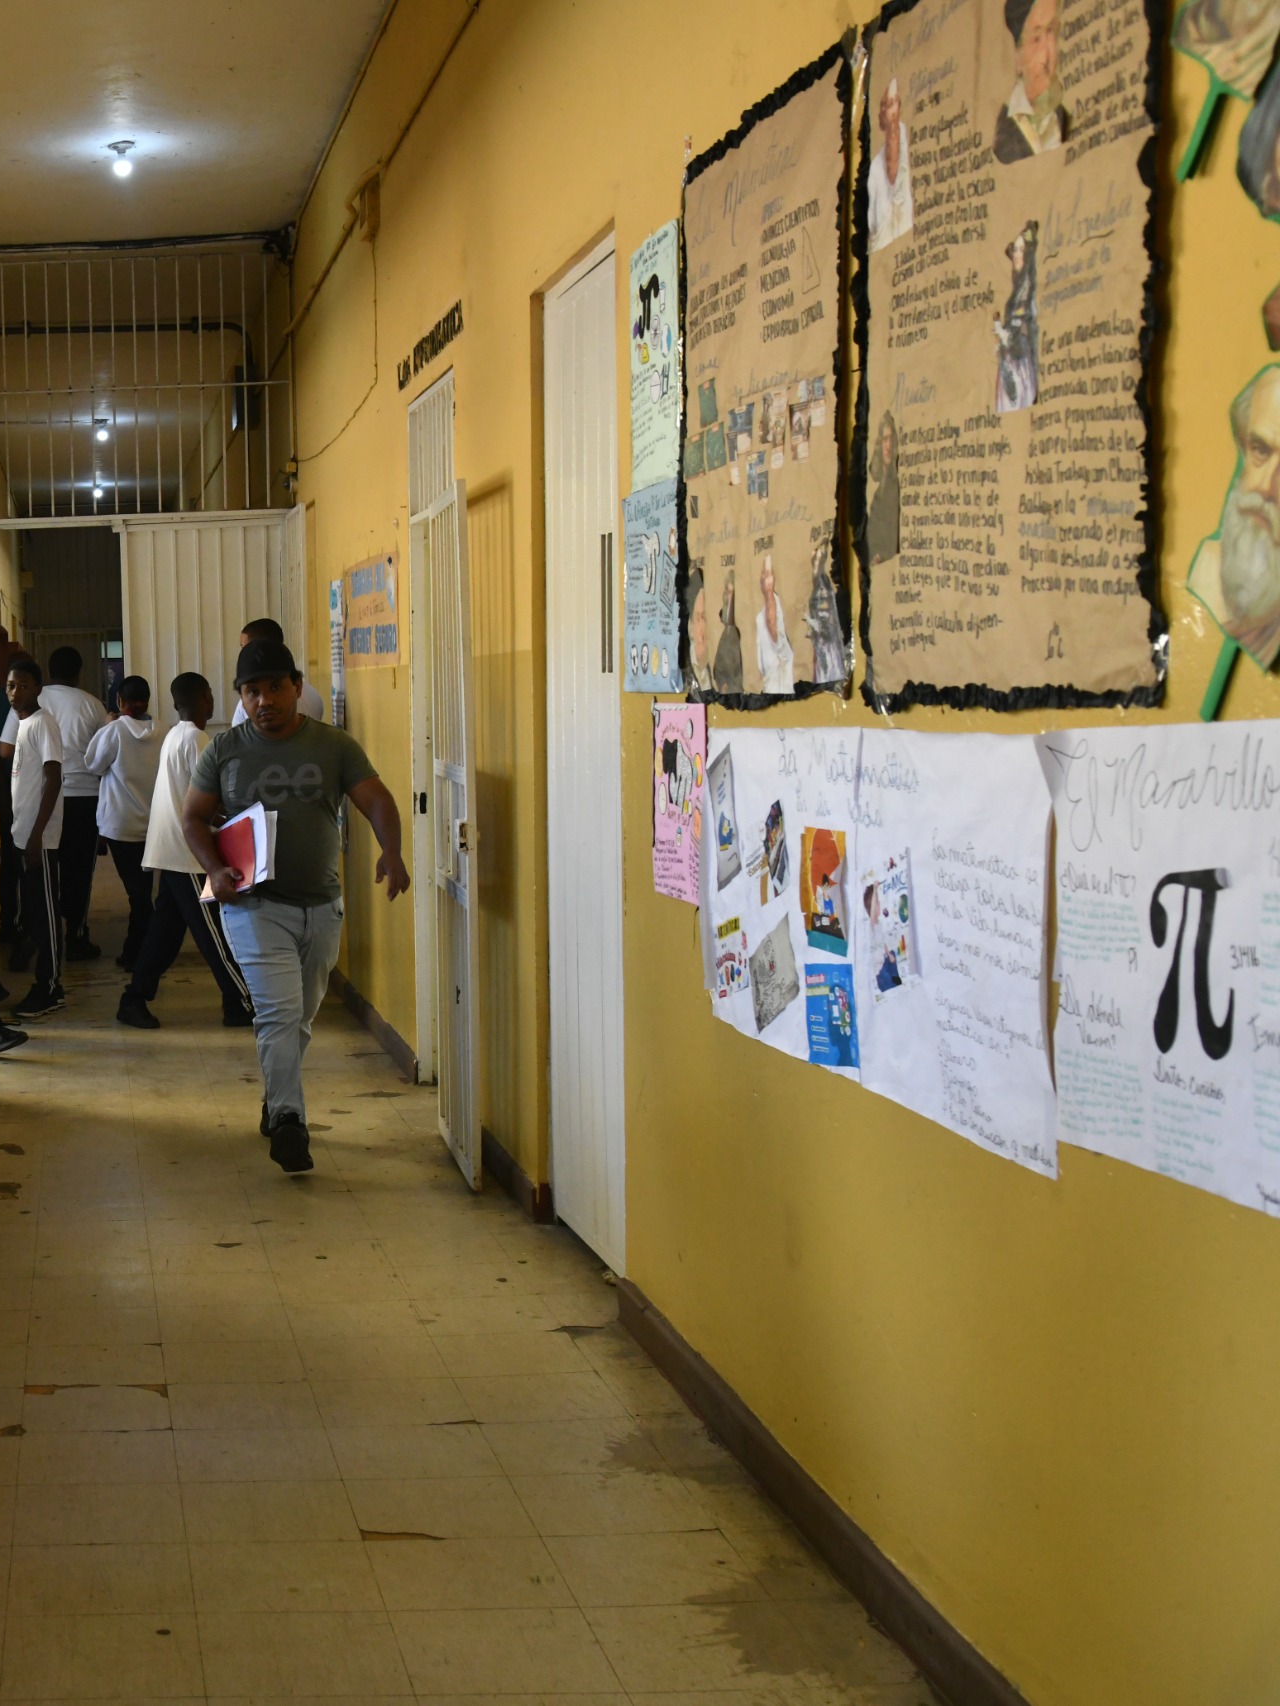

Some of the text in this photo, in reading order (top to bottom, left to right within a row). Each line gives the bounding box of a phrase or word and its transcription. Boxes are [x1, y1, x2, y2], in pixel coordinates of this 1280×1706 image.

[964, 267, 978, 287] de
[1091, 376, 1119, 396] como
[1108, 427, 1123, 451] de
[927, 469, 939, 486] de
[986, 489, 1000, 506] de
[1105, 522, 1118, 544] el
[375, 623, 397, 655] SEGURO
[220, 757, 324, 812] Lee
